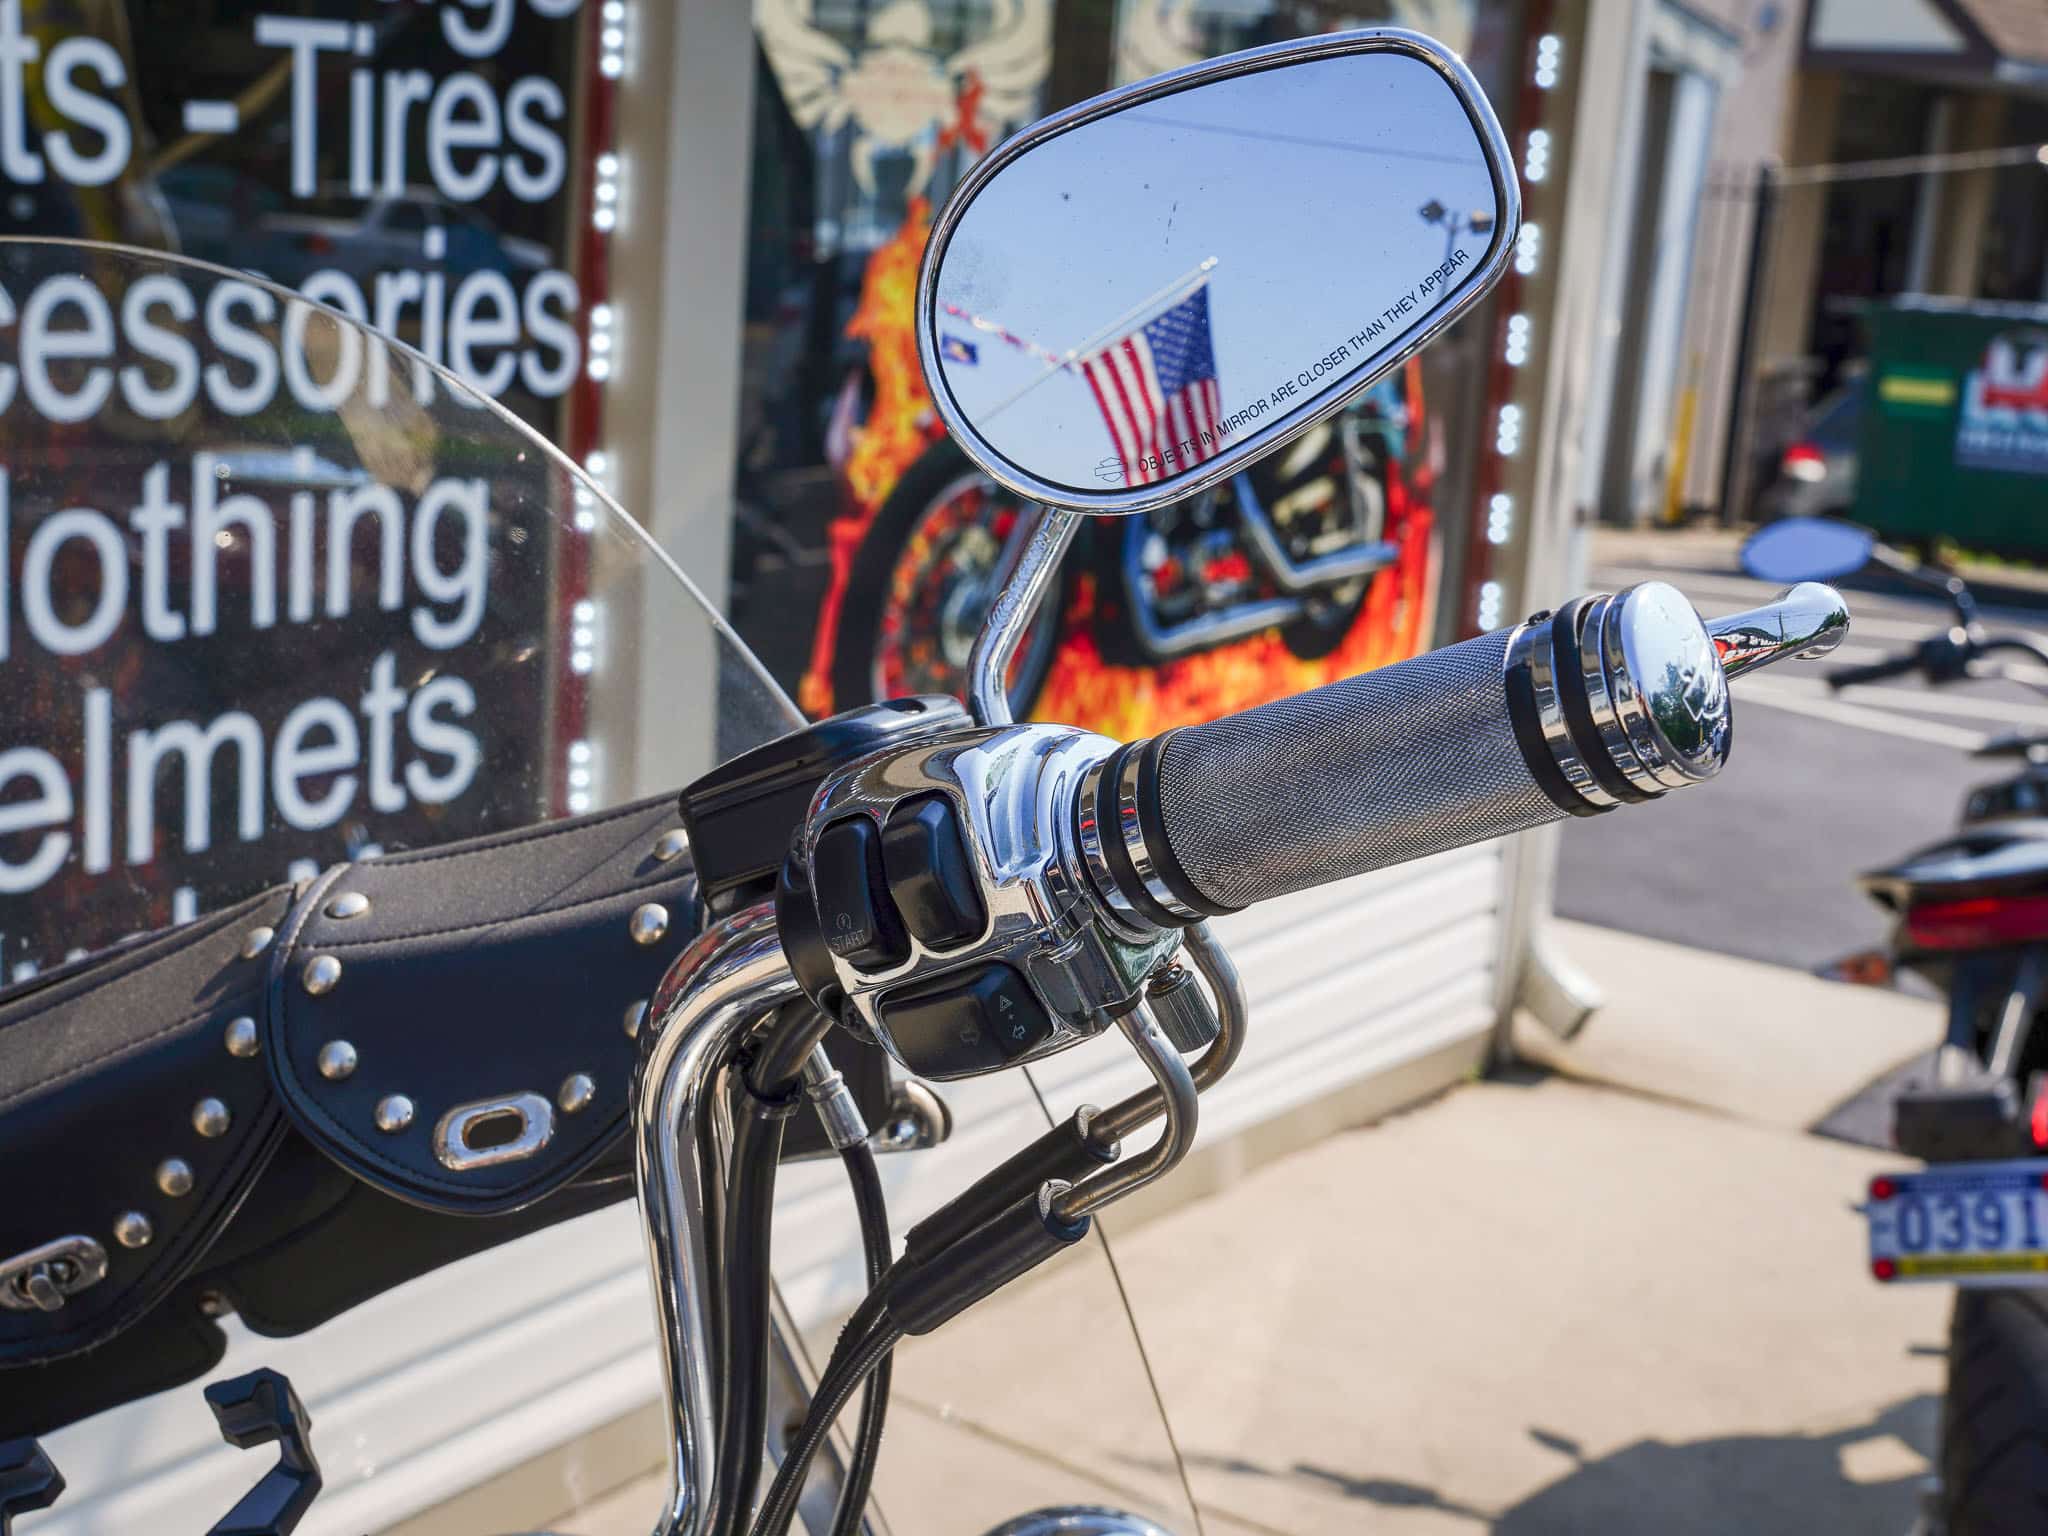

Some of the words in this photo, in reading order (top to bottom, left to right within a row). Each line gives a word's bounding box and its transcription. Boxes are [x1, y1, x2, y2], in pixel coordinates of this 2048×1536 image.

[254, 15, 567, 201] Tires
[0, 225, 581, 424] essories
[1138, 437, 1201, 473] OBJECTS
[1200, 430, 1216, 446] IN
[1216, 399, 1270, 438] MIRROR
[1270, 381, 1298, 407] ARE
[1297, 345, 1351, 388] CLOSER
[1348, 318, 1387, 351] THAN
[1382, 291, 1419, 325] THEY
[1418, 249, 1470, 297] APPEAR
[0, 650, 484, 895] elmets
[831, 929, 866, 952] START
